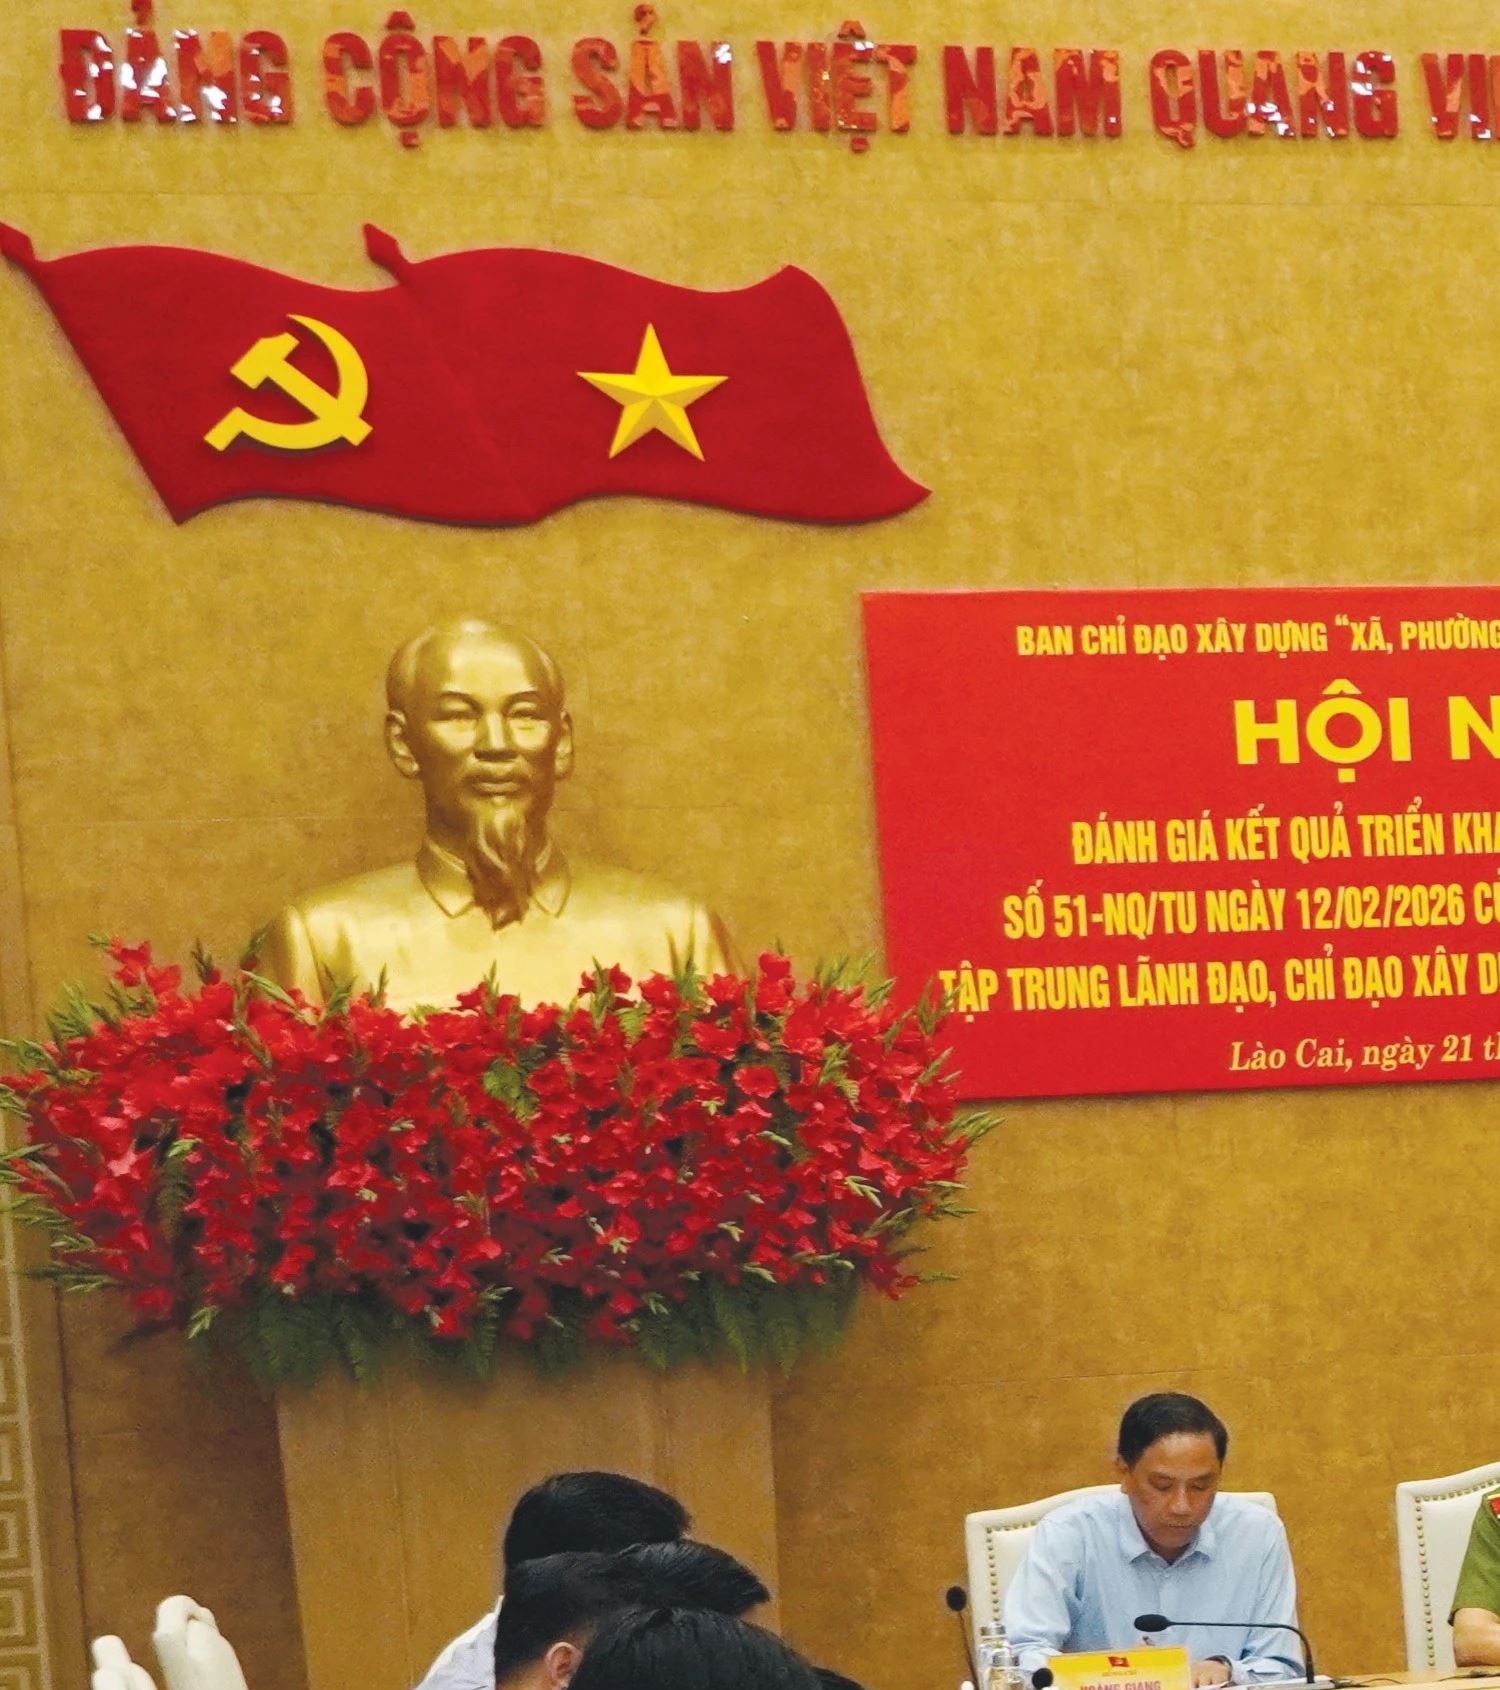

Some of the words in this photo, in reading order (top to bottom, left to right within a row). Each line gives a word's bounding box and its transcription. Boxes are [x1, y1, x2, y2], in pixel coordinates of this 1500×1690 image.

[60, 0, 290, 125] ĐẢNG
[323, 10, 545, 149] CỘNG
[571, 4, 734, 132] SẢN
[756, 19, 918, 154] VIỆT
[945, 43, 1121, 138] NAM
[1150, 49, 1398, 150] QUANG
[1016, 625, 1074, 656] BAN
[1080, 615, 1127, 655] CHỈ
[1133, 624, 1188, 661] ĐẠO
[1195, 617, 1246, 653] XÂY
[1254, 620, 1328, 658] DỰNG
[1334, 614, 1393, 654] “XÃ,
[1233, 679, 1411, 783] HỘI
[1071, 812, 1158, 864] ĐÁNH
[1165, 810, 1219, 863] GIÁ
[1225, 804, 1280, 860] KẾT
[1289, 801, 1351, 864] QUẢ
[1357, 796, 1445, 857] TRIỂN
[1003, 880, 1045, 939] SỐ
[1053, 891, 1197, 940] 51-NQ/TU
[1205, 880, 1286, 933] NGÀY
[1296, 883, 1465, 929] 12/02/2026
[938, 960, 998, 1022] TẬP
[1006, 965, 1110, 1011] TRUNG
[1118, 955, 1199, 1007] LÃNH
[1206, 960, 1276, 1013] ĐẠO,
[1284, 943, 1335, 1001] CHỈ
[1343, 955, 1403, 1008] ĐẠO
[1411, 945, 1468, 997] XÂY
[1229, 1039, 1286, 1072] Lào
[1296, 1039, 1352, 1073] Cai,
[1362, 1041, 1434, 1071] ngày
[1441, 1035, 1472, 1062] 21
